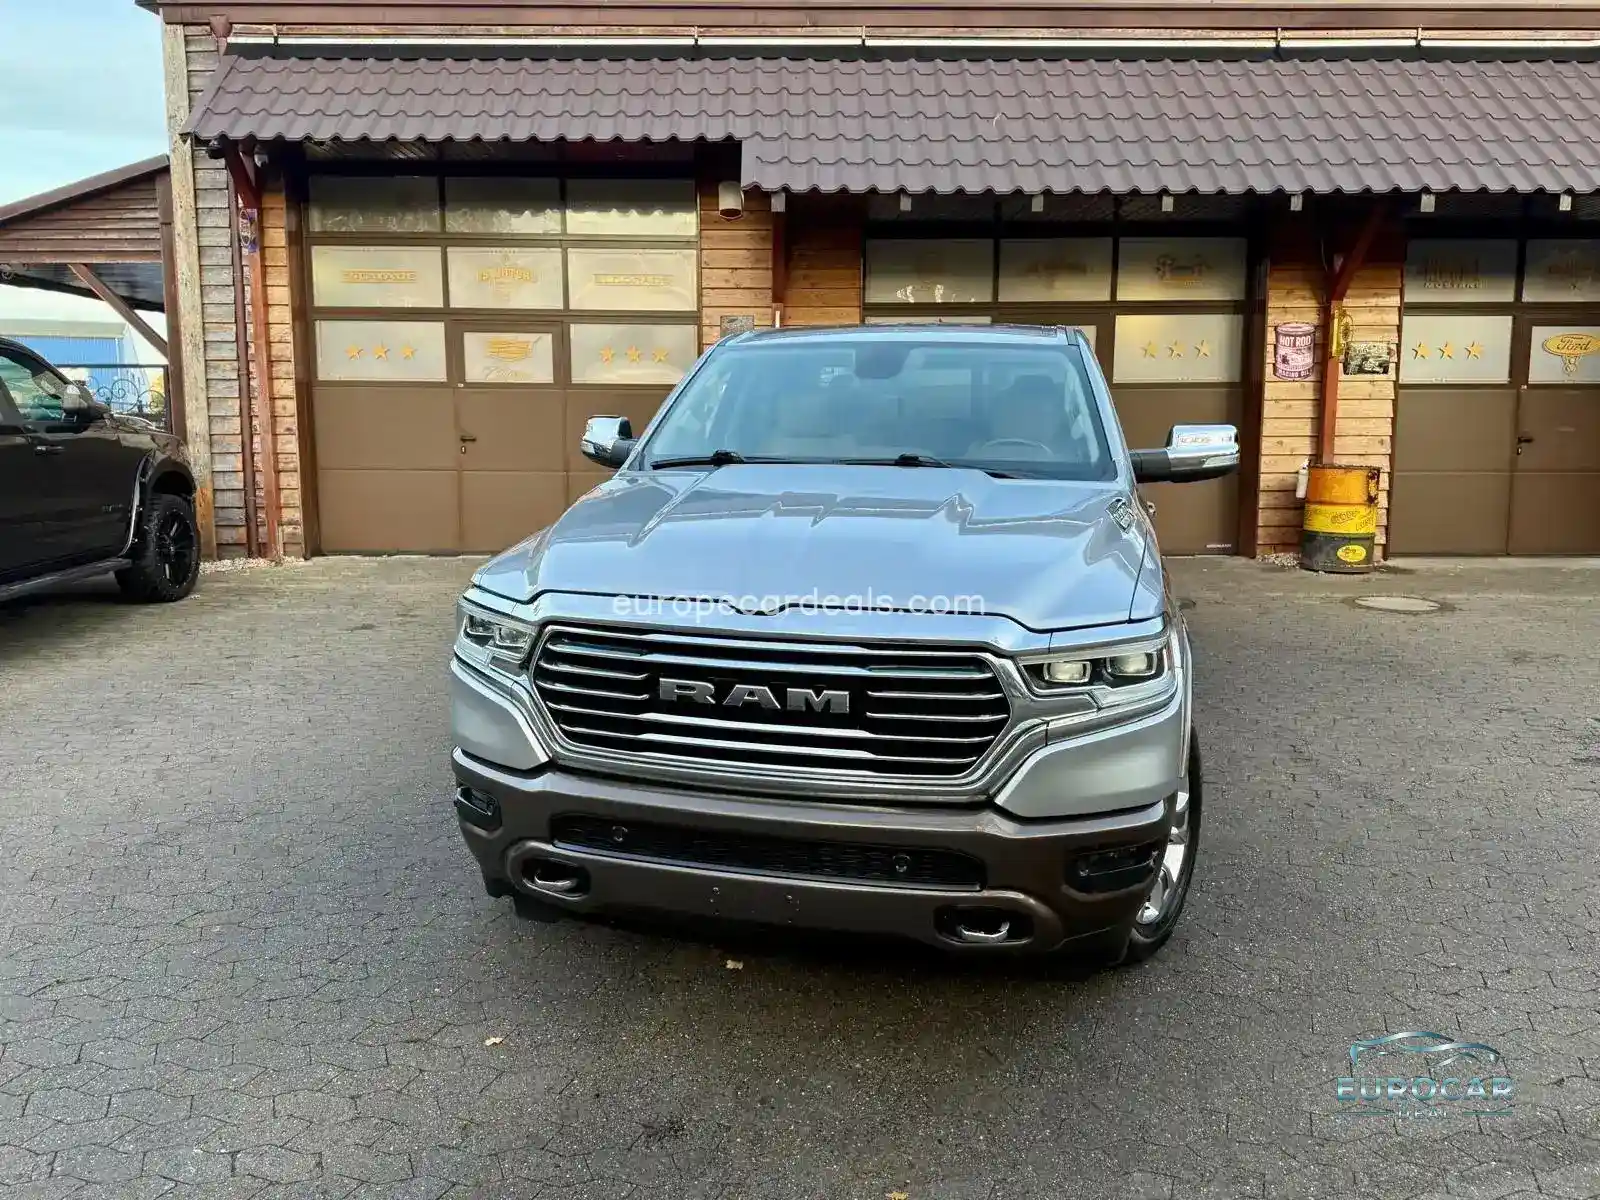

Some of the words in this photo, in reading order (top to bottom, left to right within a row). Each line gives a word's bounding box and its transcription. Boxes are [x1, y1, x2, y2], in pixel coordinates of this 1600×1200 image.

[1279, 335, 1295, 347] HOT
[1296, 335, 1311, 347] ROD
[1557, 338, 1592, 351] Ford
[659, 677, 850, 714] RAM
